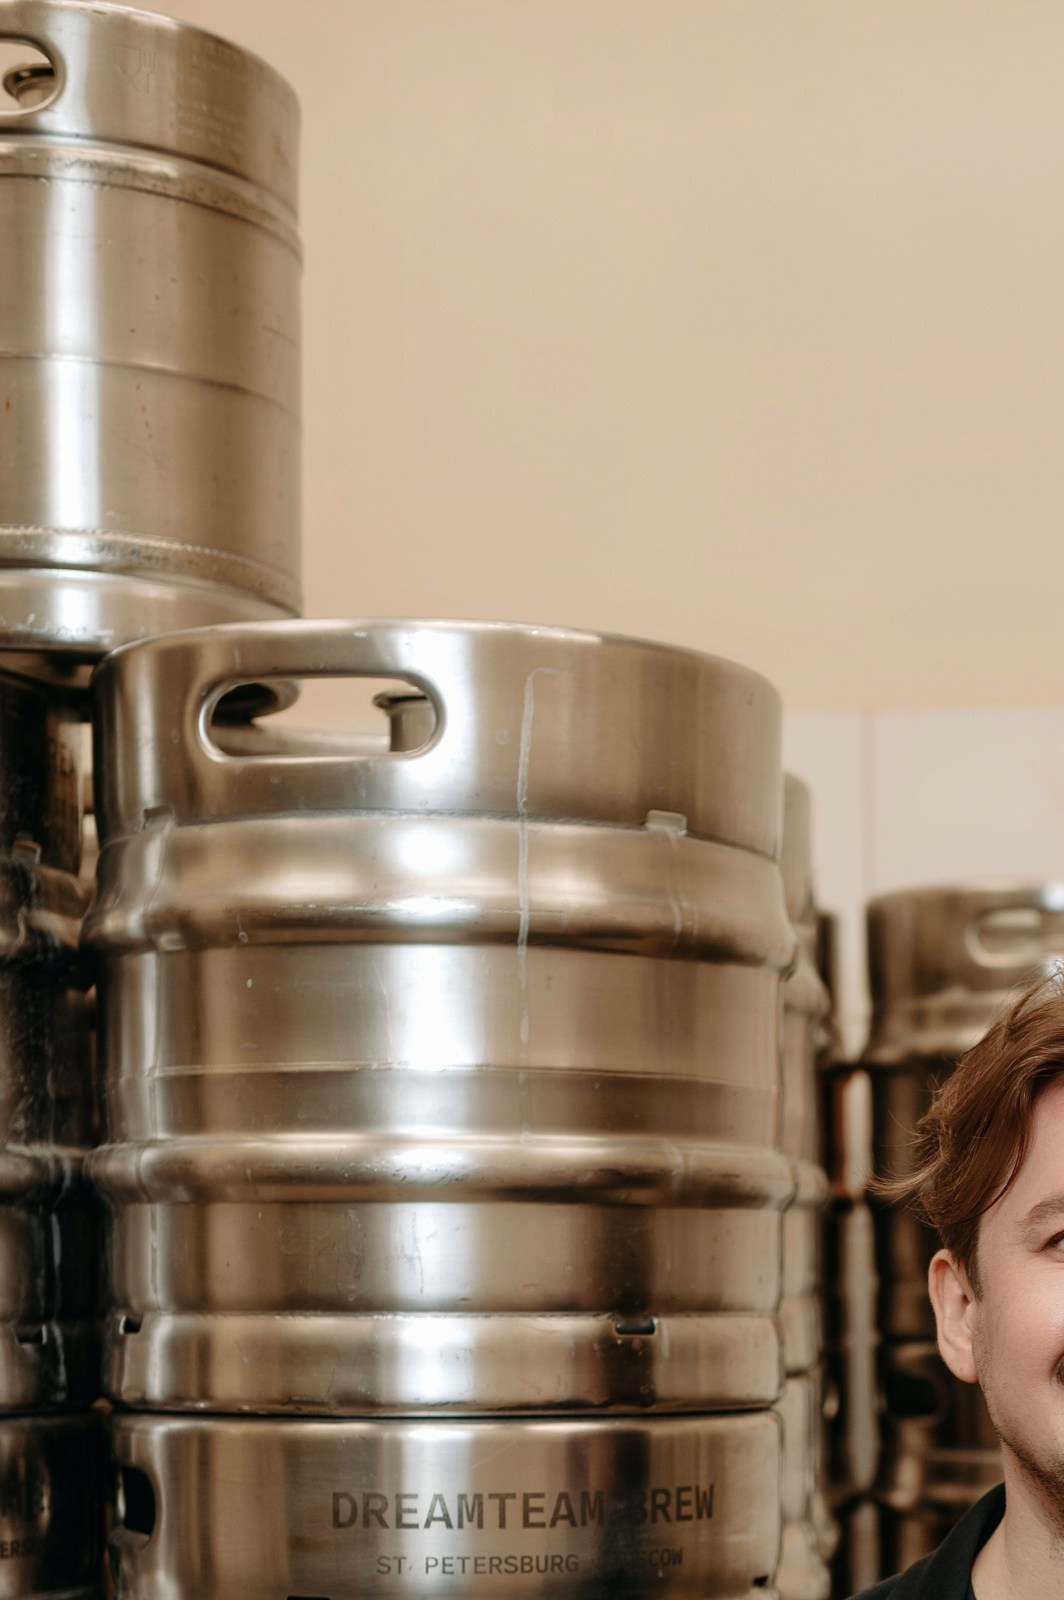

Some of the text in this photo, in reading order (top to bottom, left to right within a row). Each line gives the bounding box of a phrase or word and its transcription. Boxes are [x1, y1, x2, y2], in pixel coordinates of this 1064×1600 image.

[331, 1484, 715, 1530] DREAMTEAM BREW
[424, 1553, 579, 1575] PETERSBURG
